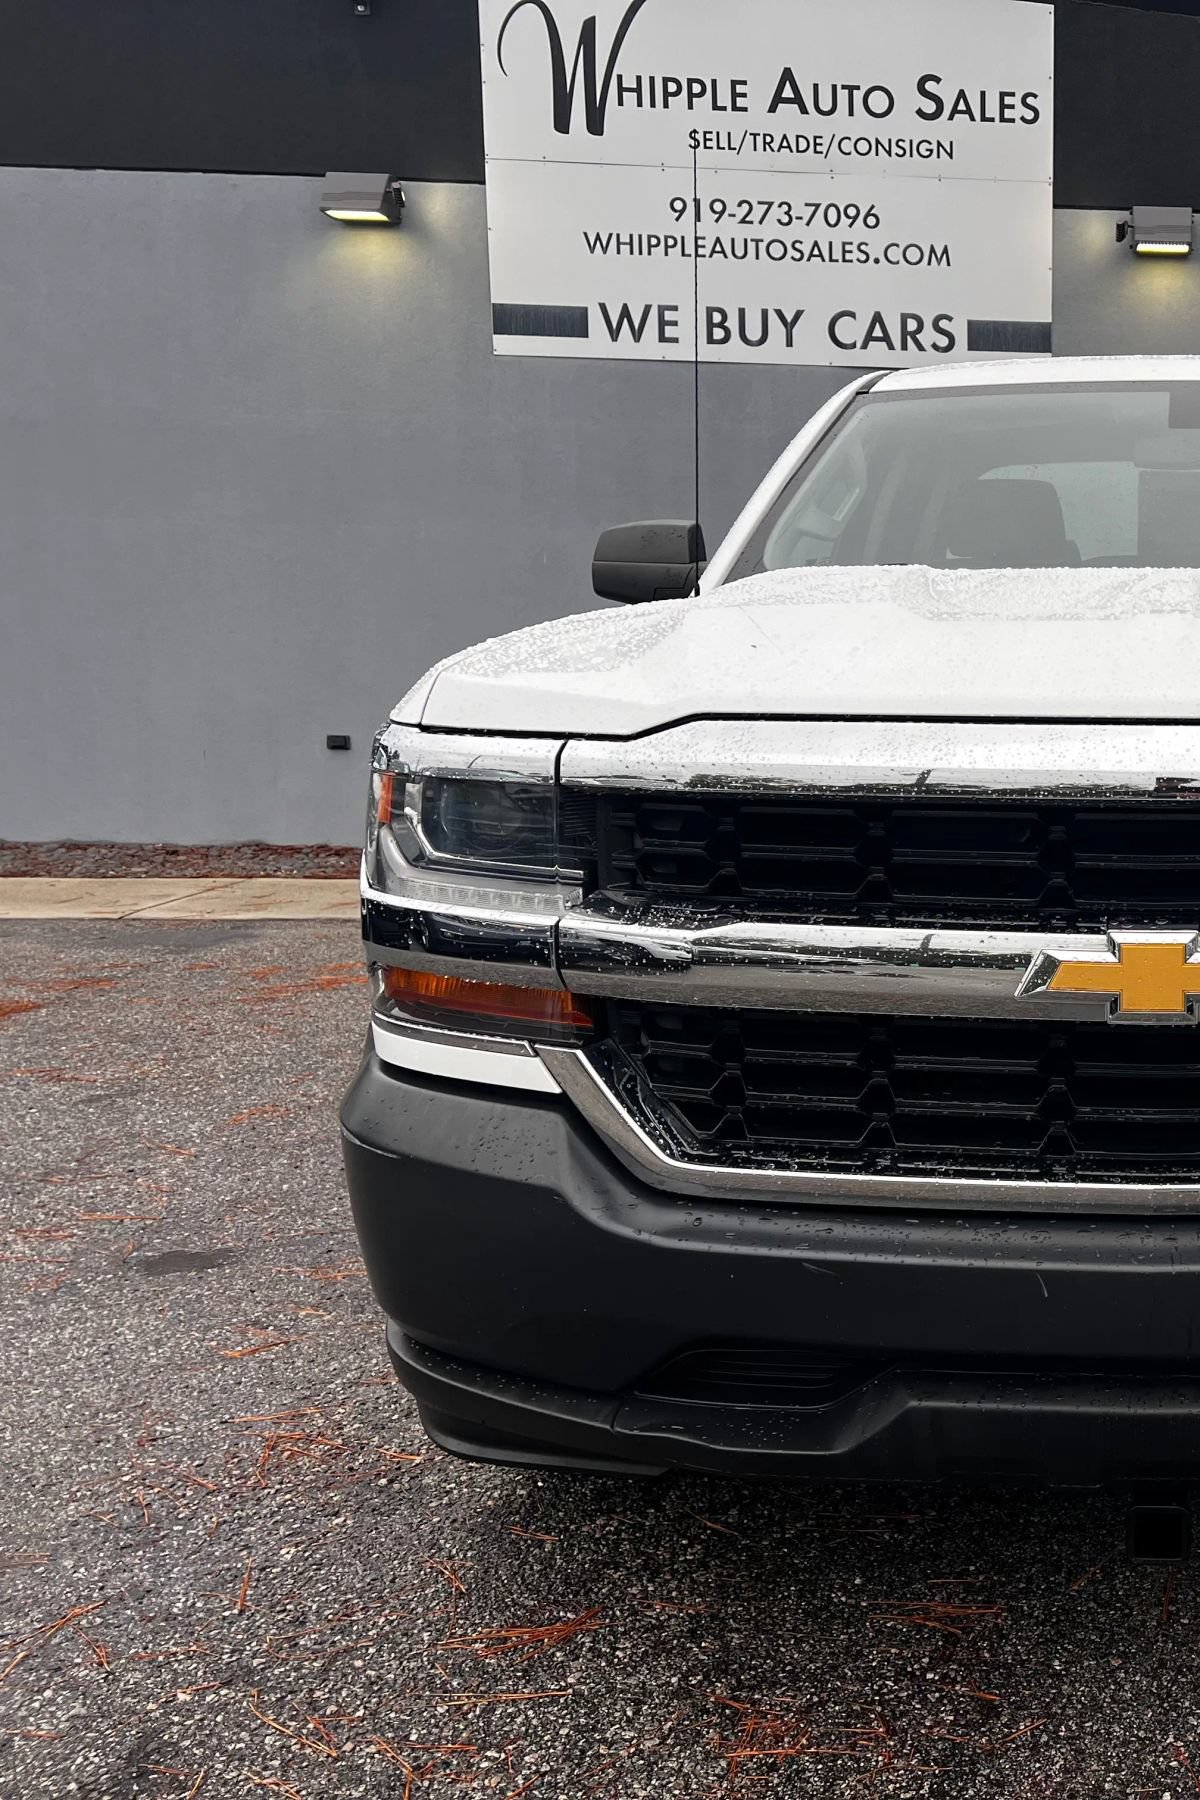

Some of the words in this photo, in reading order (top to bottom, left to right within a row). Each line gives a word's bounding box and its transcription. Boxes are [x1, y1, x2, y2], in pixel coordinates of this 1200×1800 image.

[496, 0, 749, 137] WHIPPLE
[766, 66, 895, 119] AUTO
[914, 73, 1040, 125] SALES
[688, 128, 954, 160] SELL/TRADE/CONSIGN
[668, 196, 881, 230] 919-273-7096
[582, 231, 951, 267] WHIPPLEAUTOSALES.COM
[597, 302, 680, 344] WE
[705, 305, 805, 348] BUY
[827, 309, 956, 354] CARS
